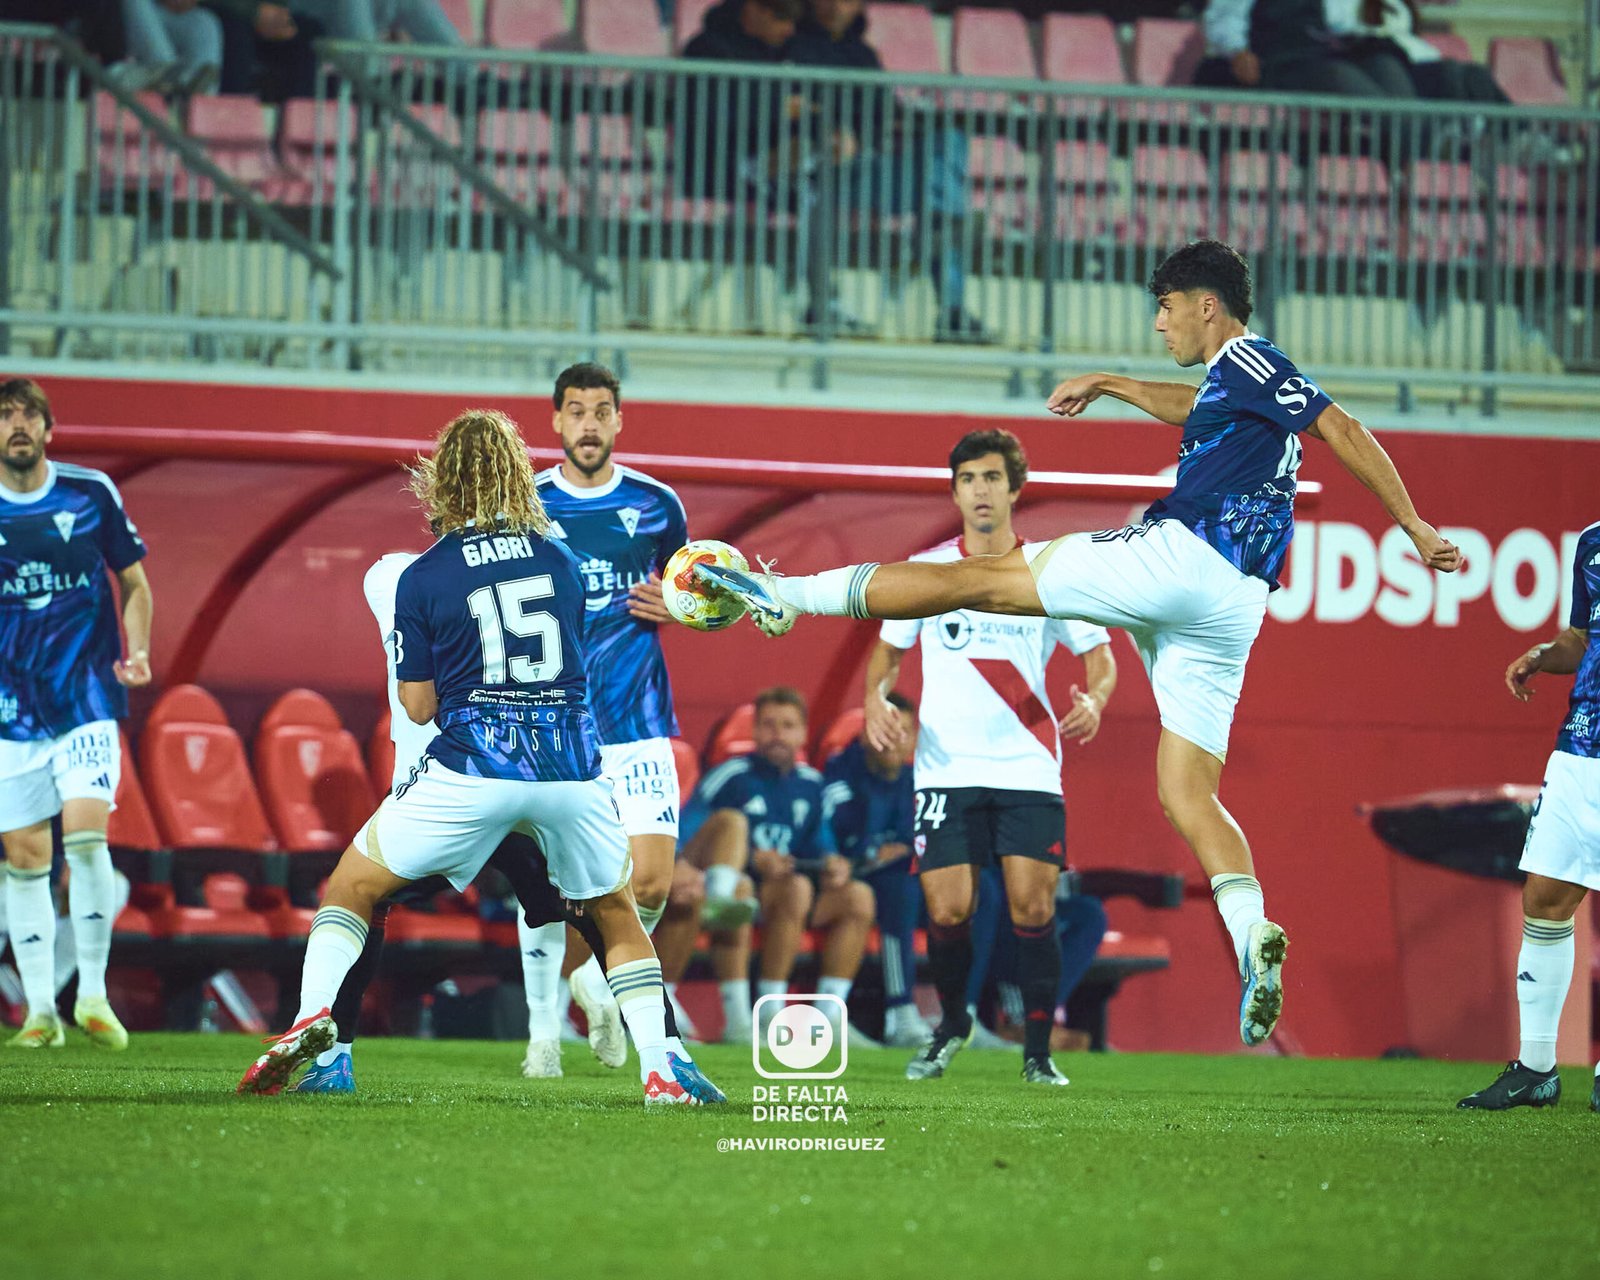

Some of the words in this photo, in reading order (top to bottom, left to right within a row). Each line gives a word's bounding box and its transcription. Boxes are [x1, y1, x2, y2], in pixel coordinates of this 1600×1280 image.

[461, 536, 534, 567] GABRI
[467, 574, 563, 685] 15
[485, 726, 561, 751] MOSH
[914, 791, 947, 831] 24
